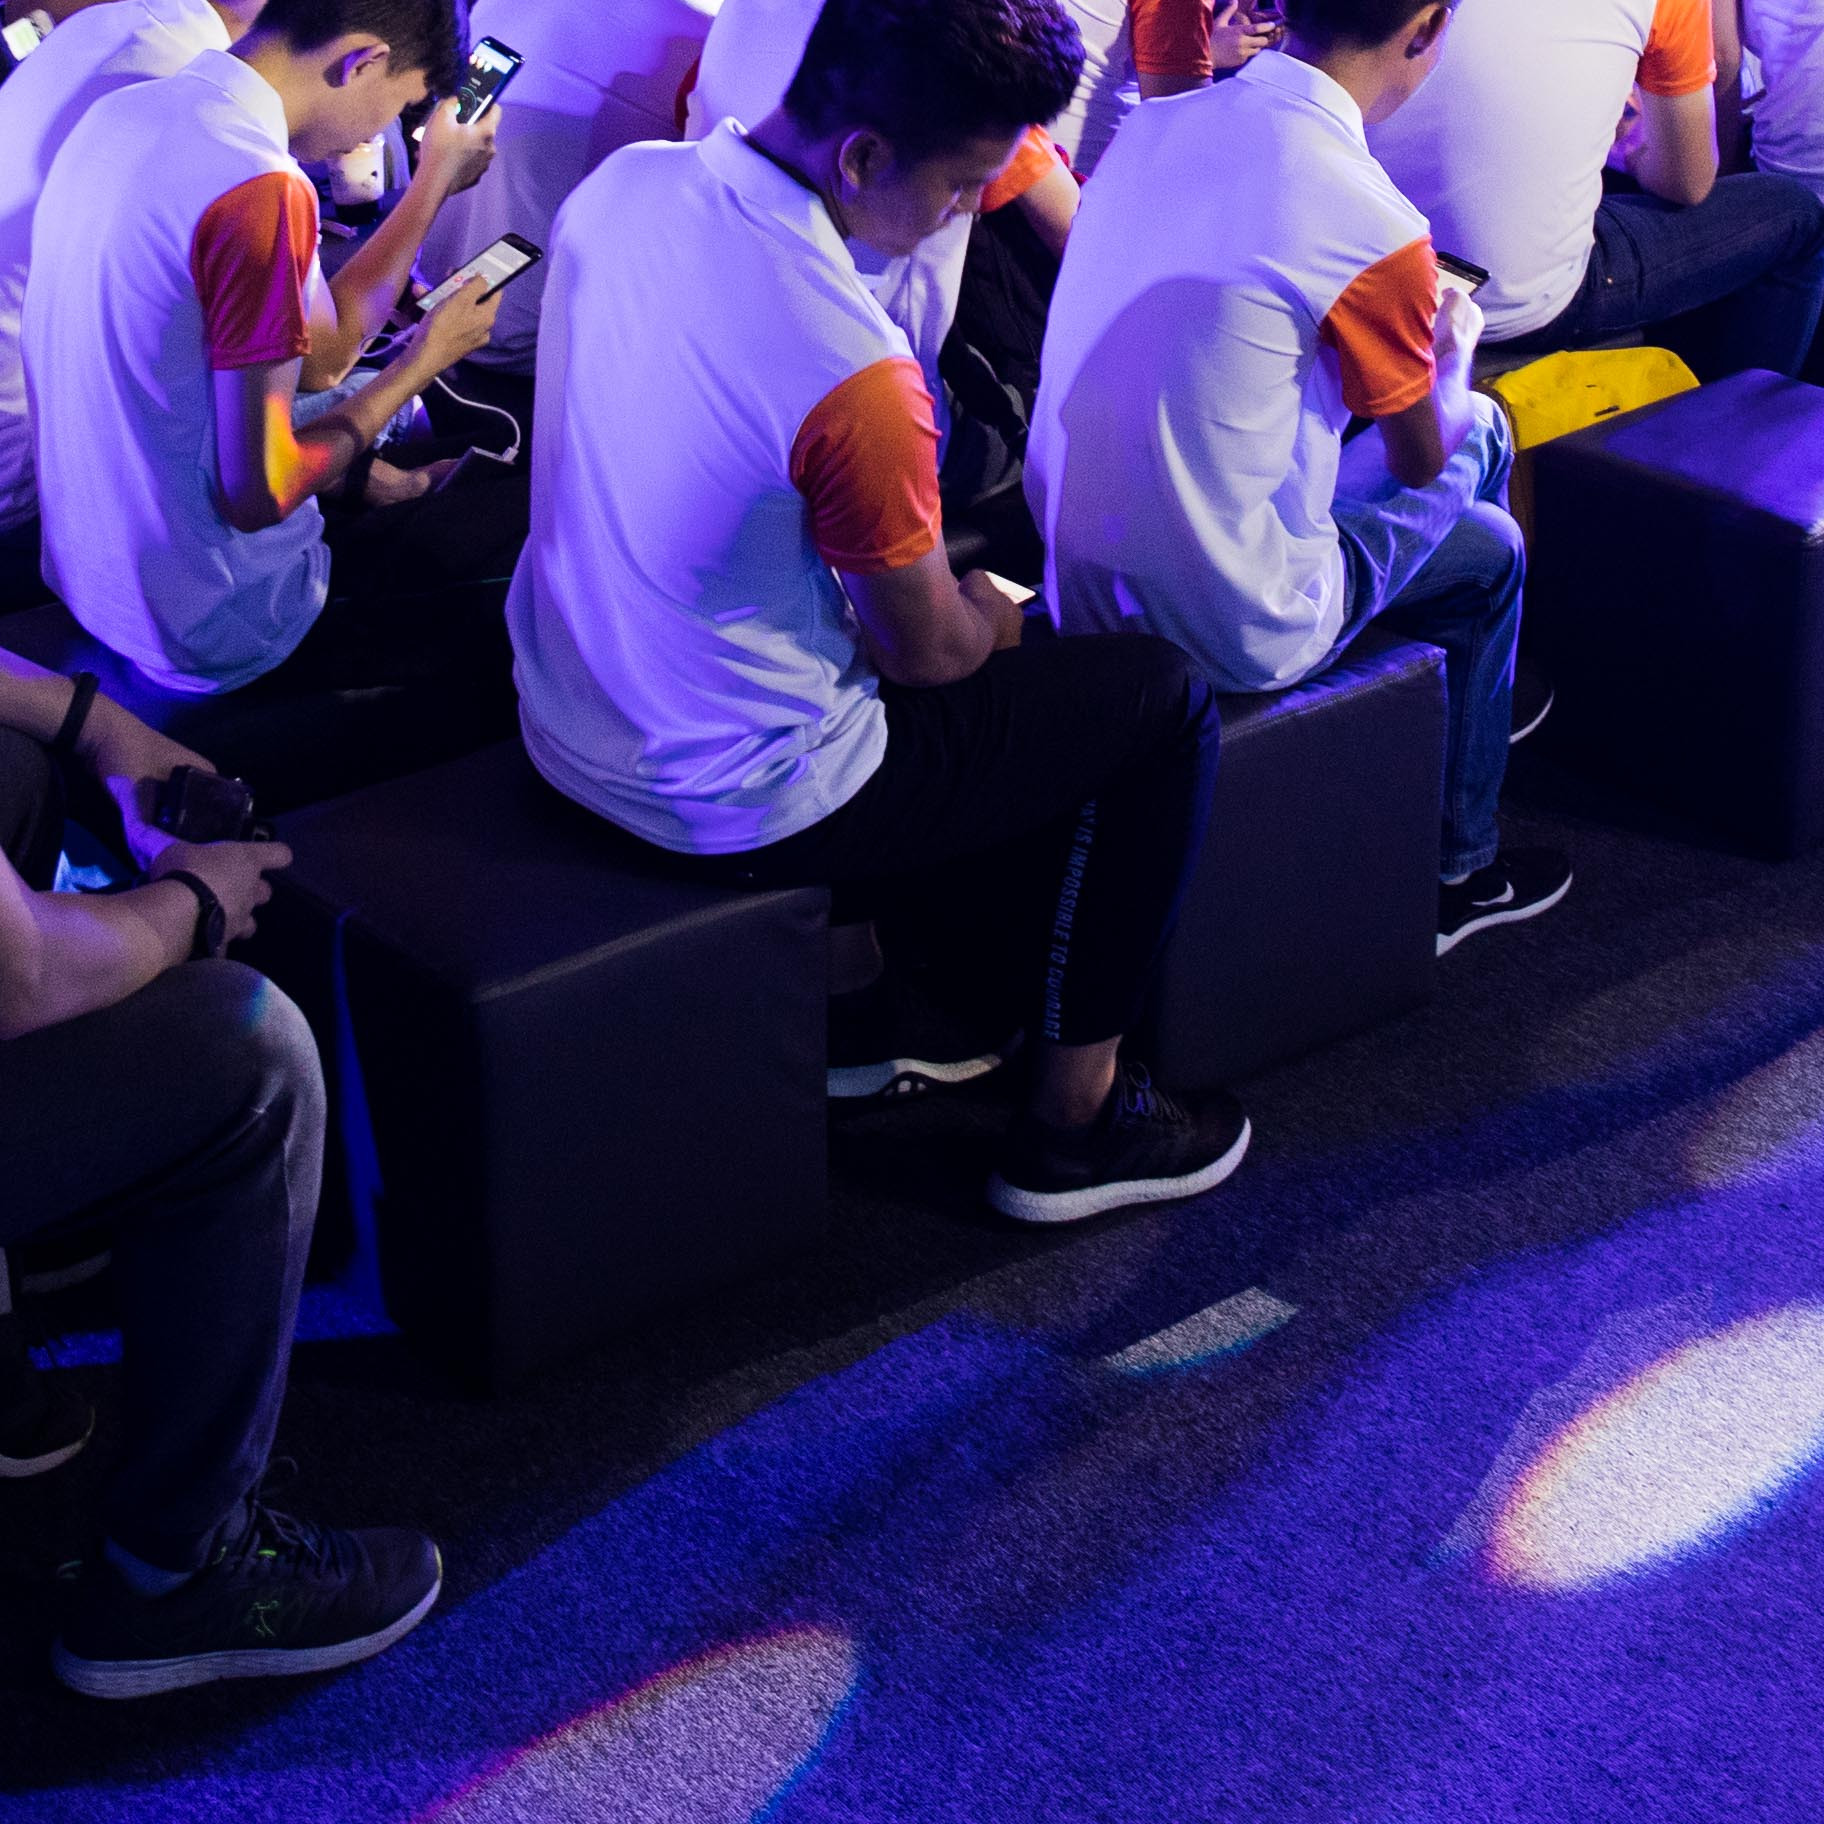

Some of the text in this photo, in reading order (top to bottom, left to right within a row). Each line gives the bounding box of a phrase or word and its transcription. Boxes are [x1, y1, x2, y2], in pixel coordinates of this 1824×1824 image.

[1053, 845, 1089, 942] IMPOSSIBLE
[1049, 943, 1069, 965] TO
[1040, 966, 1065, 1041] COURAGE
